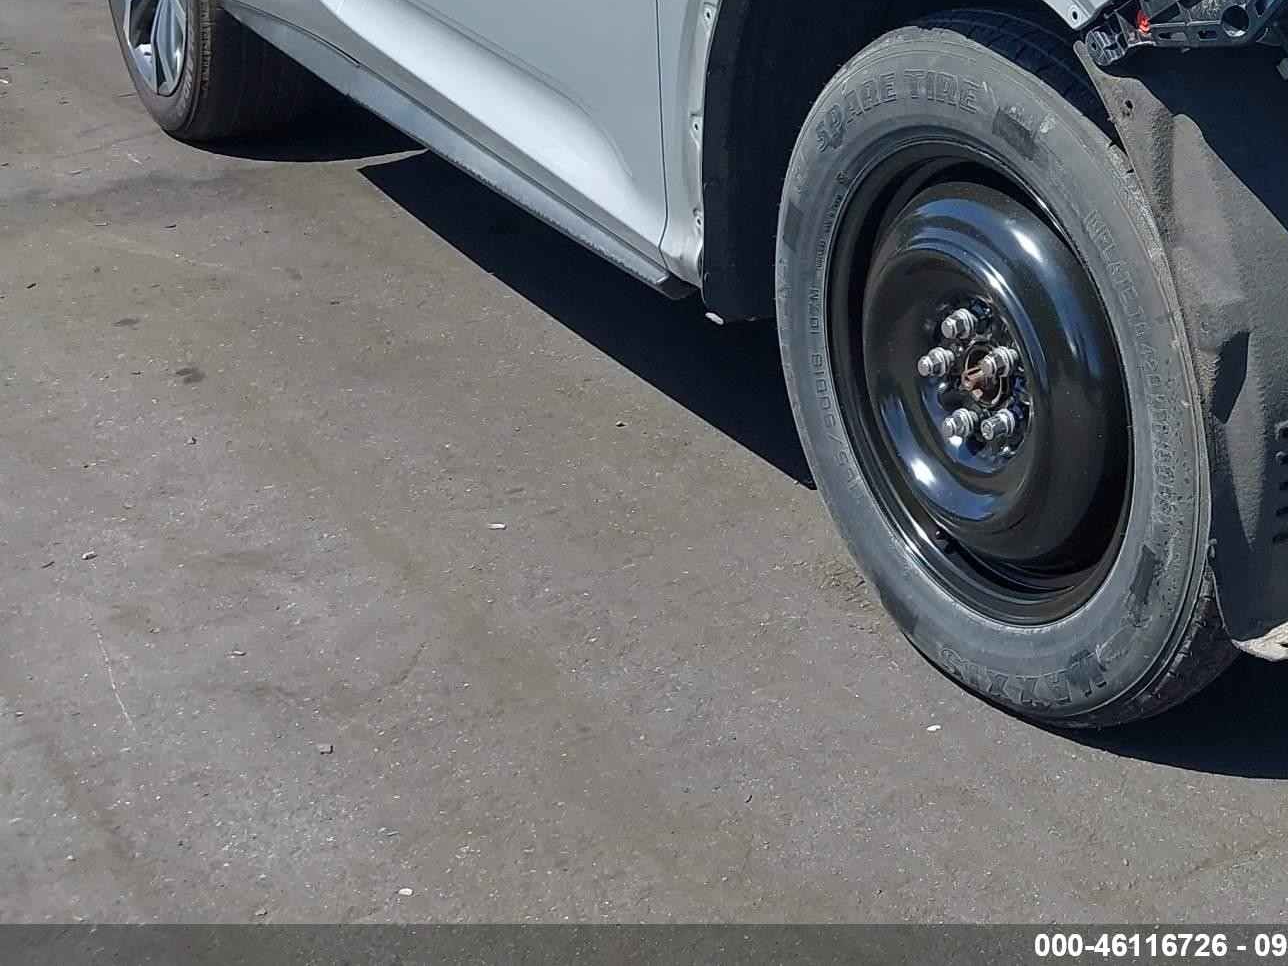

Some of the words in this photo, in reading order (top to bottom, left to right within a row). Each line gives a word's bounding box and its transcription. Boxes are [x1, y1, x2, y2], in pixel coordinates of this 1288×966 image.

[816, 71, 898, 154] SPARE
[903, 67, 982, 115] TIRE
[1083, 208, 1138, 303] INFLATE
[939, 647, 1108, 707] MAXXIS
